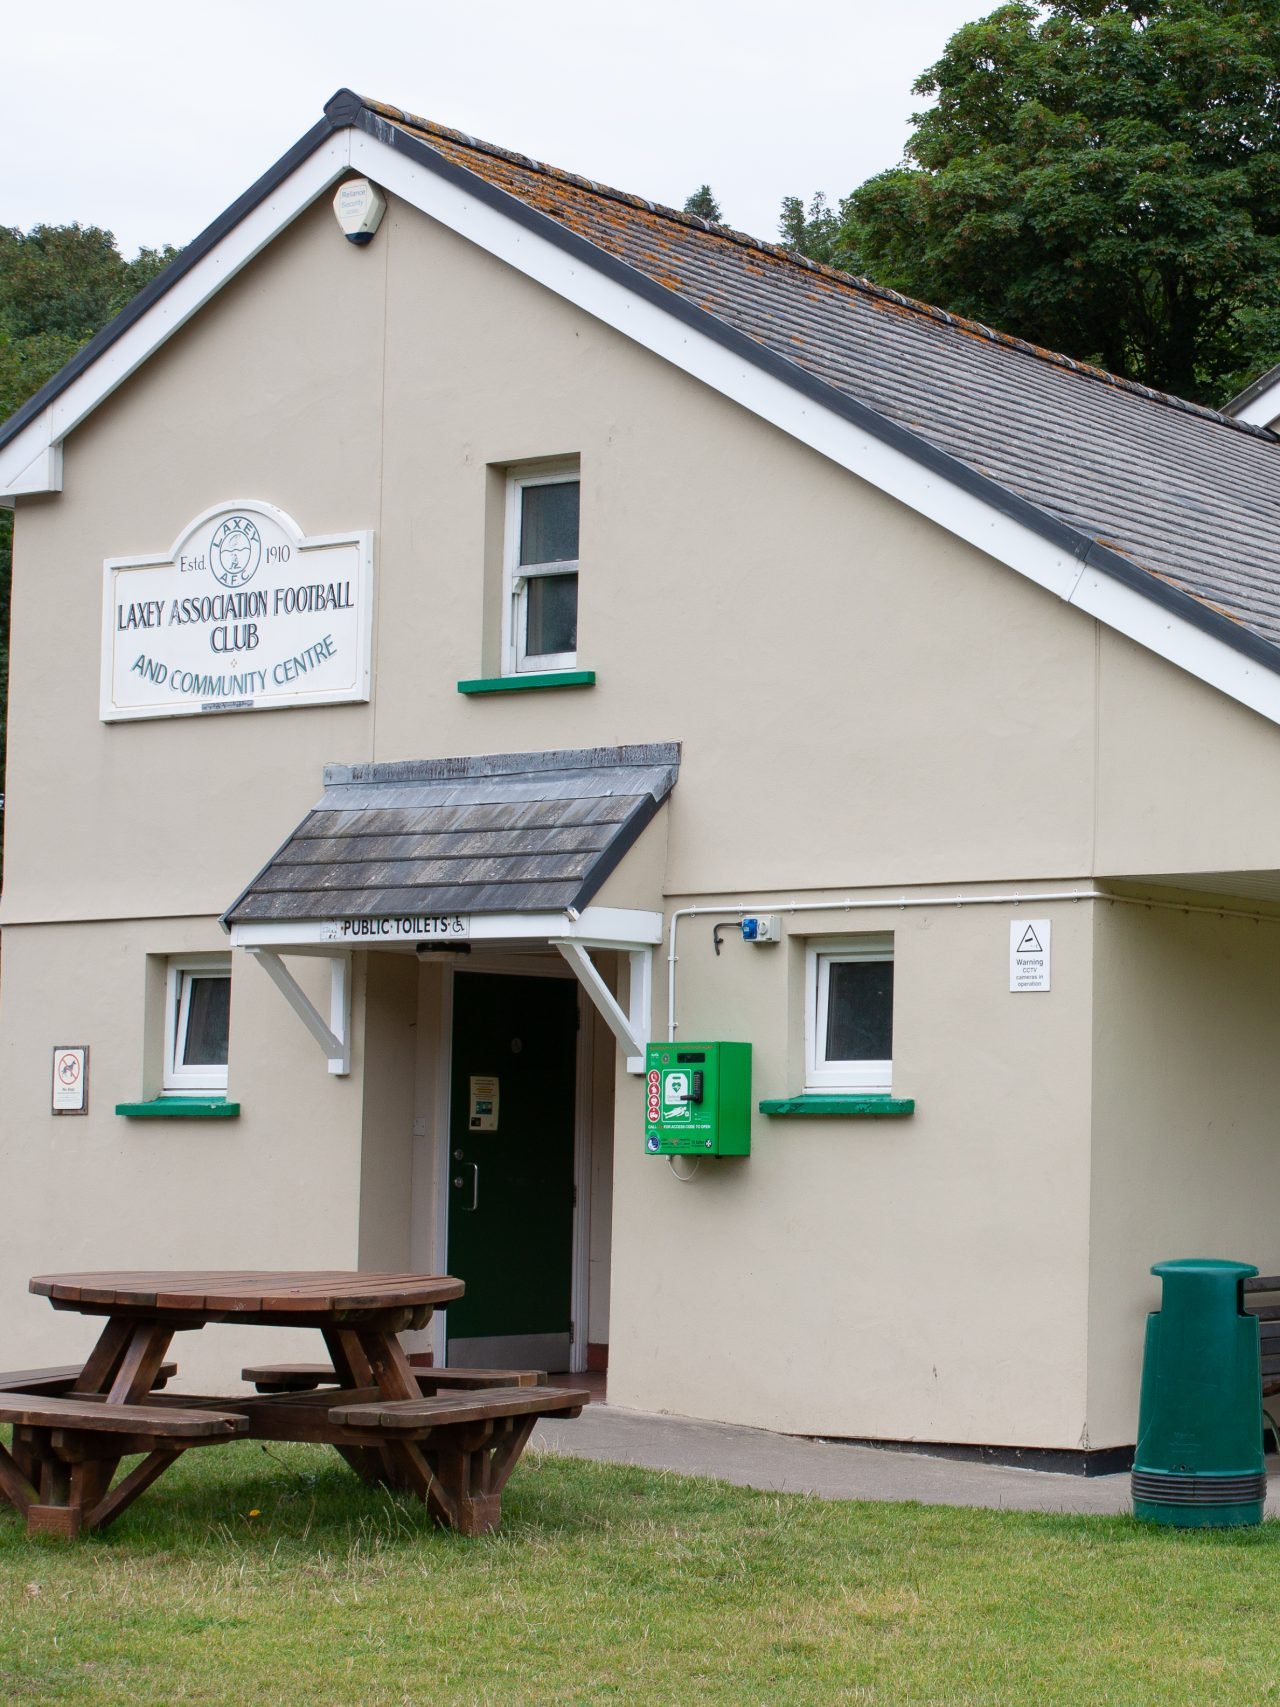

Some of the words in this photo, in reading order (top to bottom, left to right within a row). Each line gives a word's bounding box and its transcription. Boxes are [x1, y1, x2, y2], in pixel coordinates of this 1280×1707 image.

[212, 519, 260, 549] LAXEY
[180, 556, 207, 572] Estd.
[266, 545, 290, 563] 1910
[117, 600, 165, 631] LAXEY
[169, 591, 268, 626] ASSOCIATION
[274, 582, 354, 615] FOOTBALL
[210, 624, 260, 653] CLUB
[131, 654, 168, 685] AND
[170, 669, 267, 697] COMMUNITY
[273, 634, 338, 686] CENTRE
[344, 919, 390, 936] PUBLIC
[394, 916, 448, 934] TOILETS
